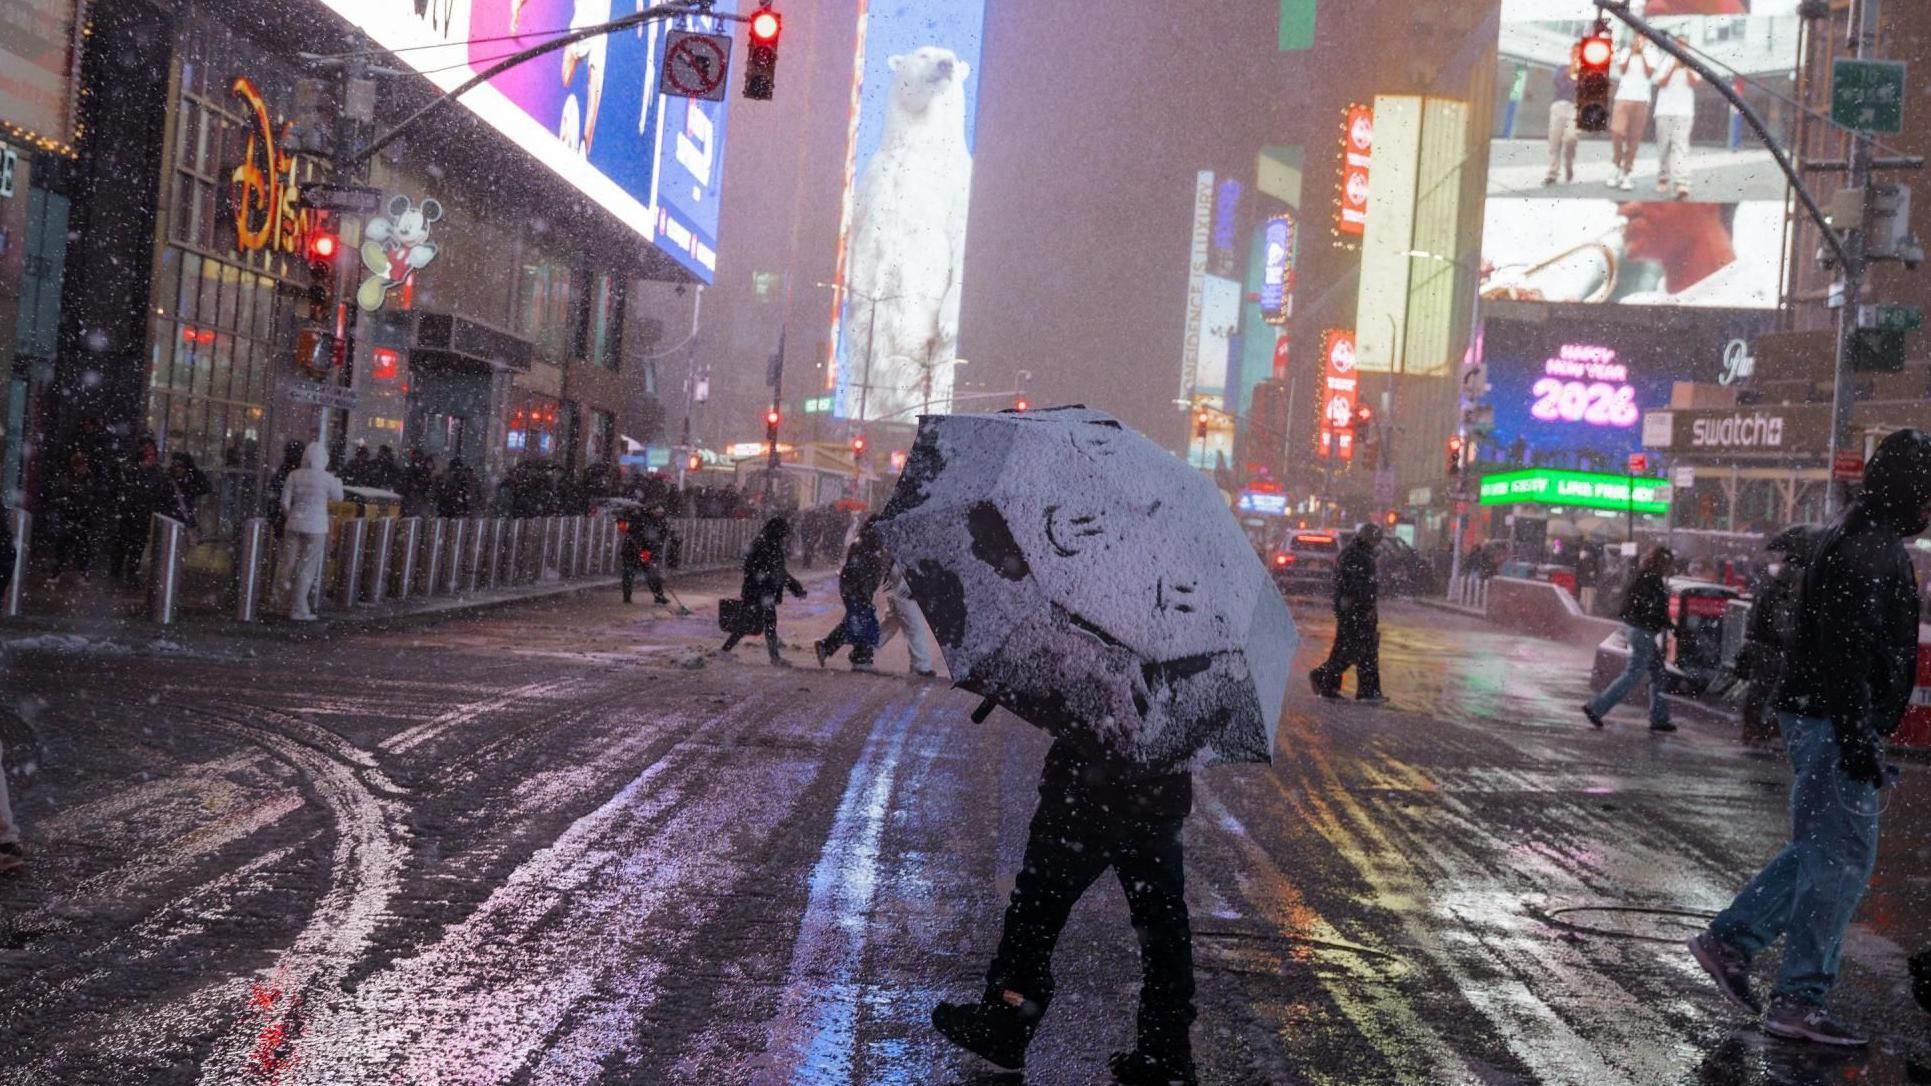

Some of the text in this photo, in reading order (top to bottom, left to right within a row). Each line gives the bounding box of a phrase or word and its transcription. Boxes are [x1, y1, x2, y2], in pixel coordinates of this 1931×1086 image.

[1193, 181, 1214, 257] LUXURY
[1545, 358, 1627, 381] NEW YEAR
[1560, 344, 1615, 364] HAPPY
[1531, 377, 1639, 426] 2026
[1691, 411, 1767, 446] swatch
